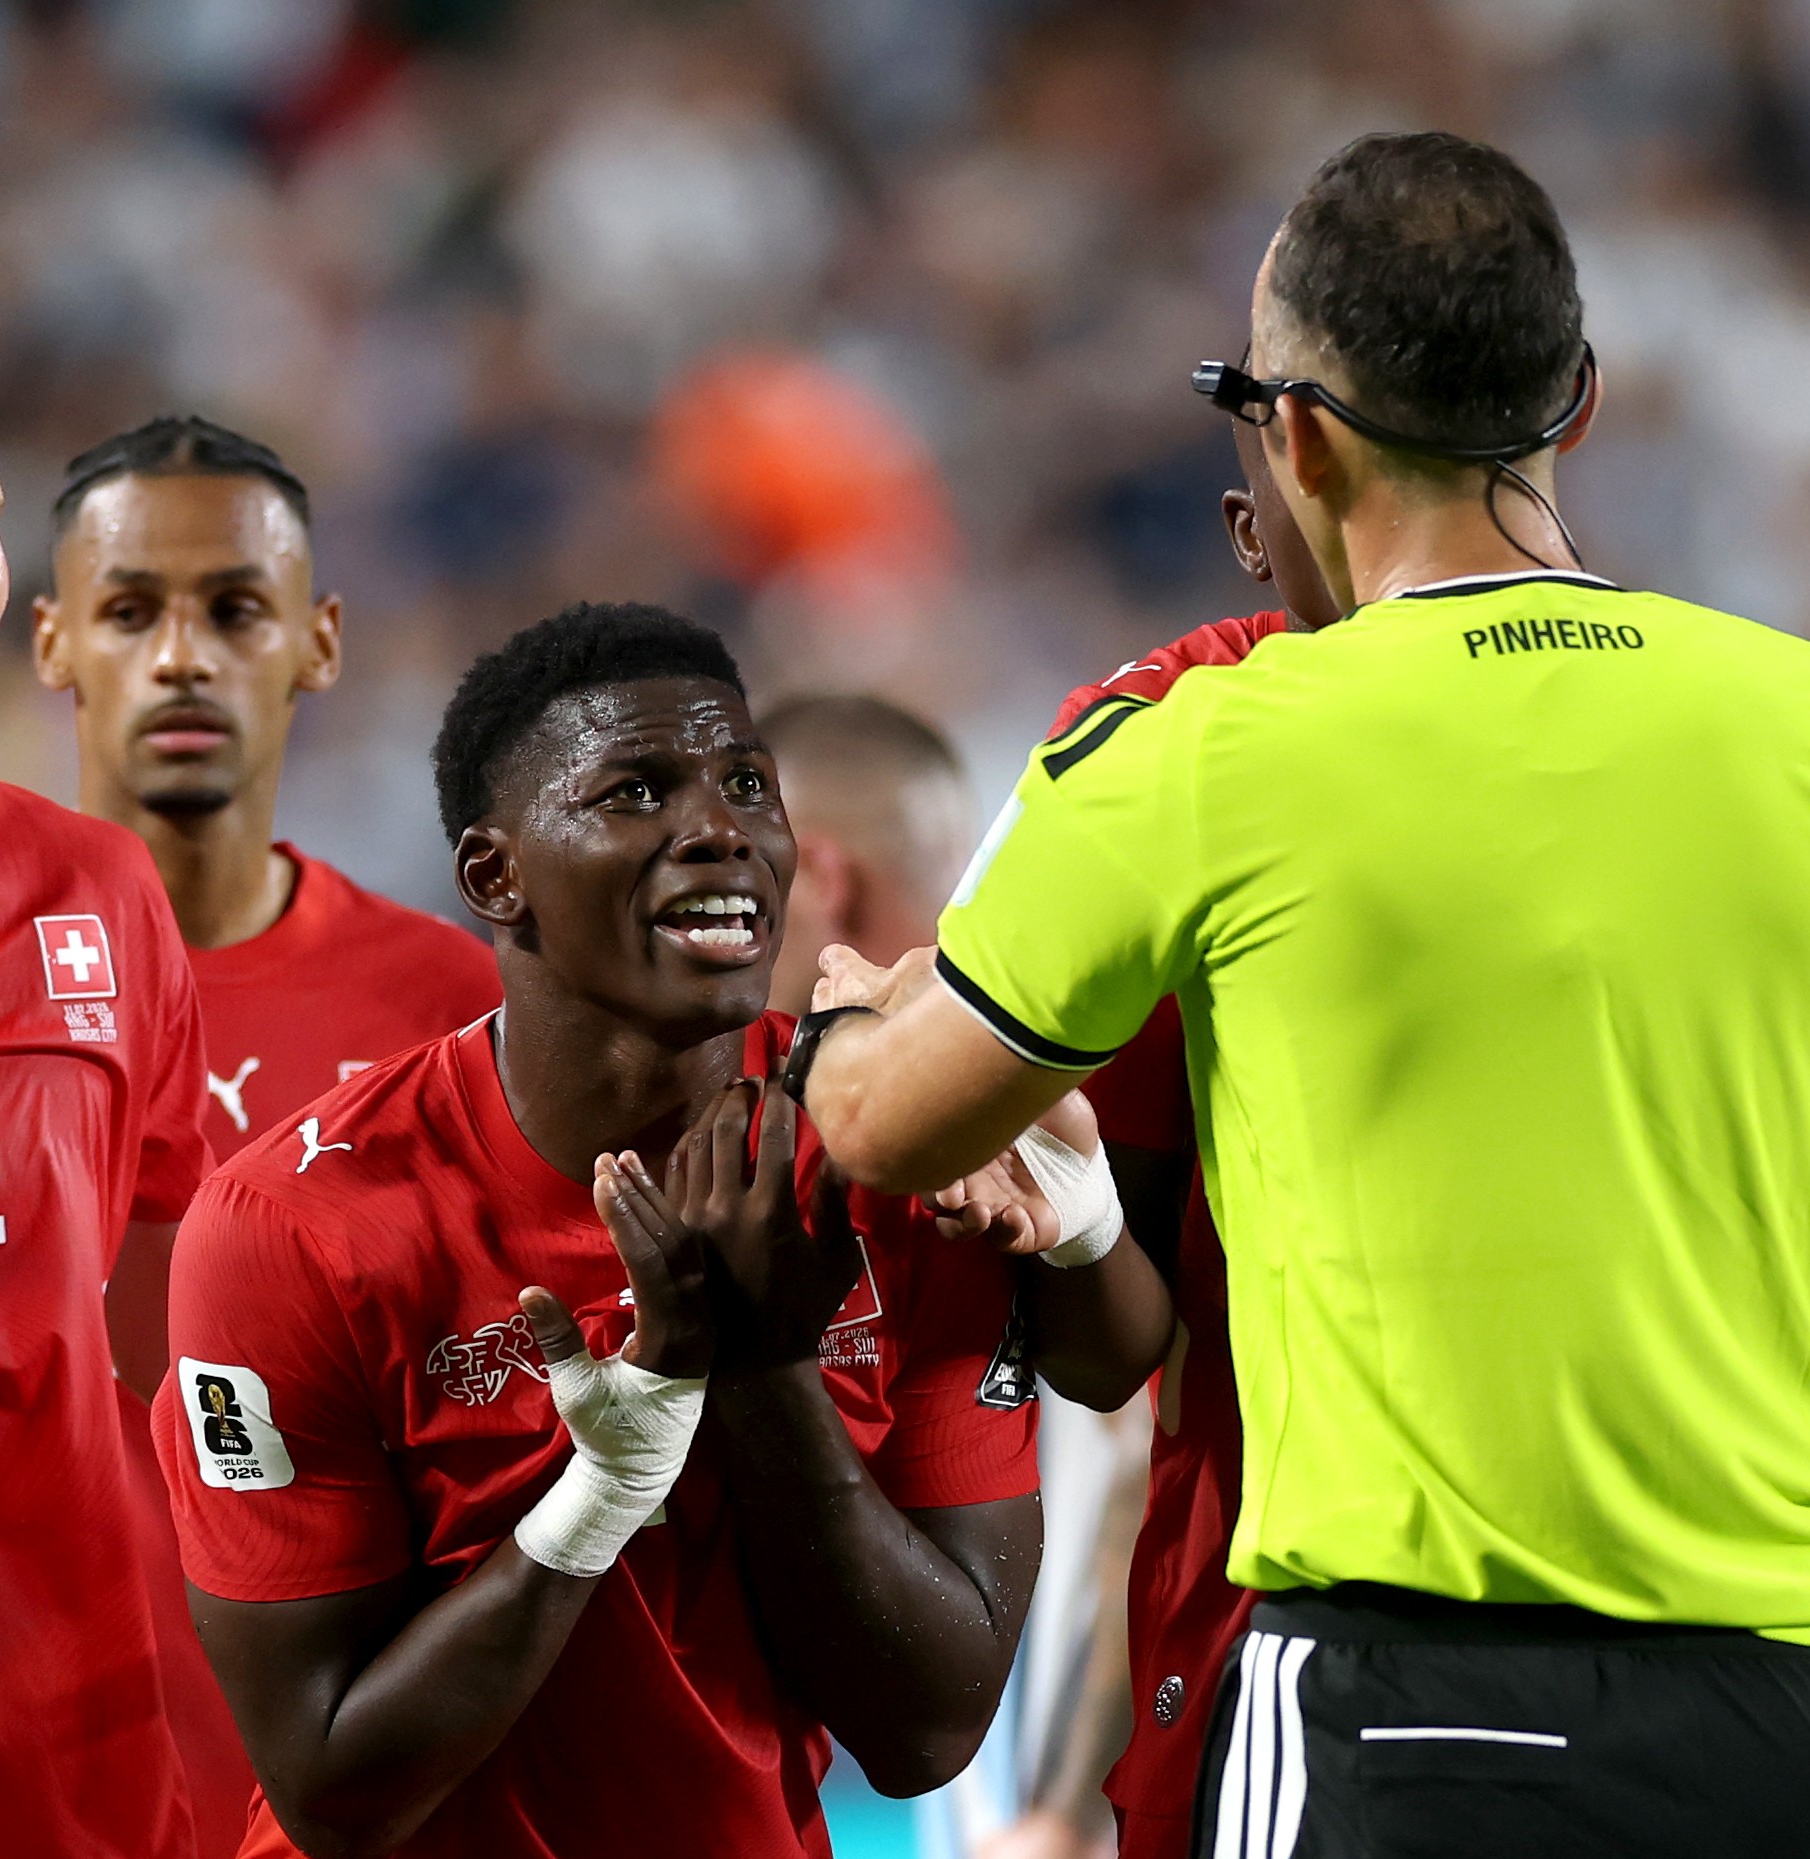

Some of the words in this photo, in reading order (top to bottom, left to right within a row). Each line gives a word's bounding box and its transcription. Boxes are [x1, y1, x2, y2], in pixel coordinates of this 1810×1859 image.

[1462, 622, 1645, 661] PINHEIRO
[819, 1355, 853, 1368] ANSAS
[220, 1438, 242, 1450] FIFA
[243, 1458, 261, 1467] CUP
[220, 1467, 265, 1481] 026
